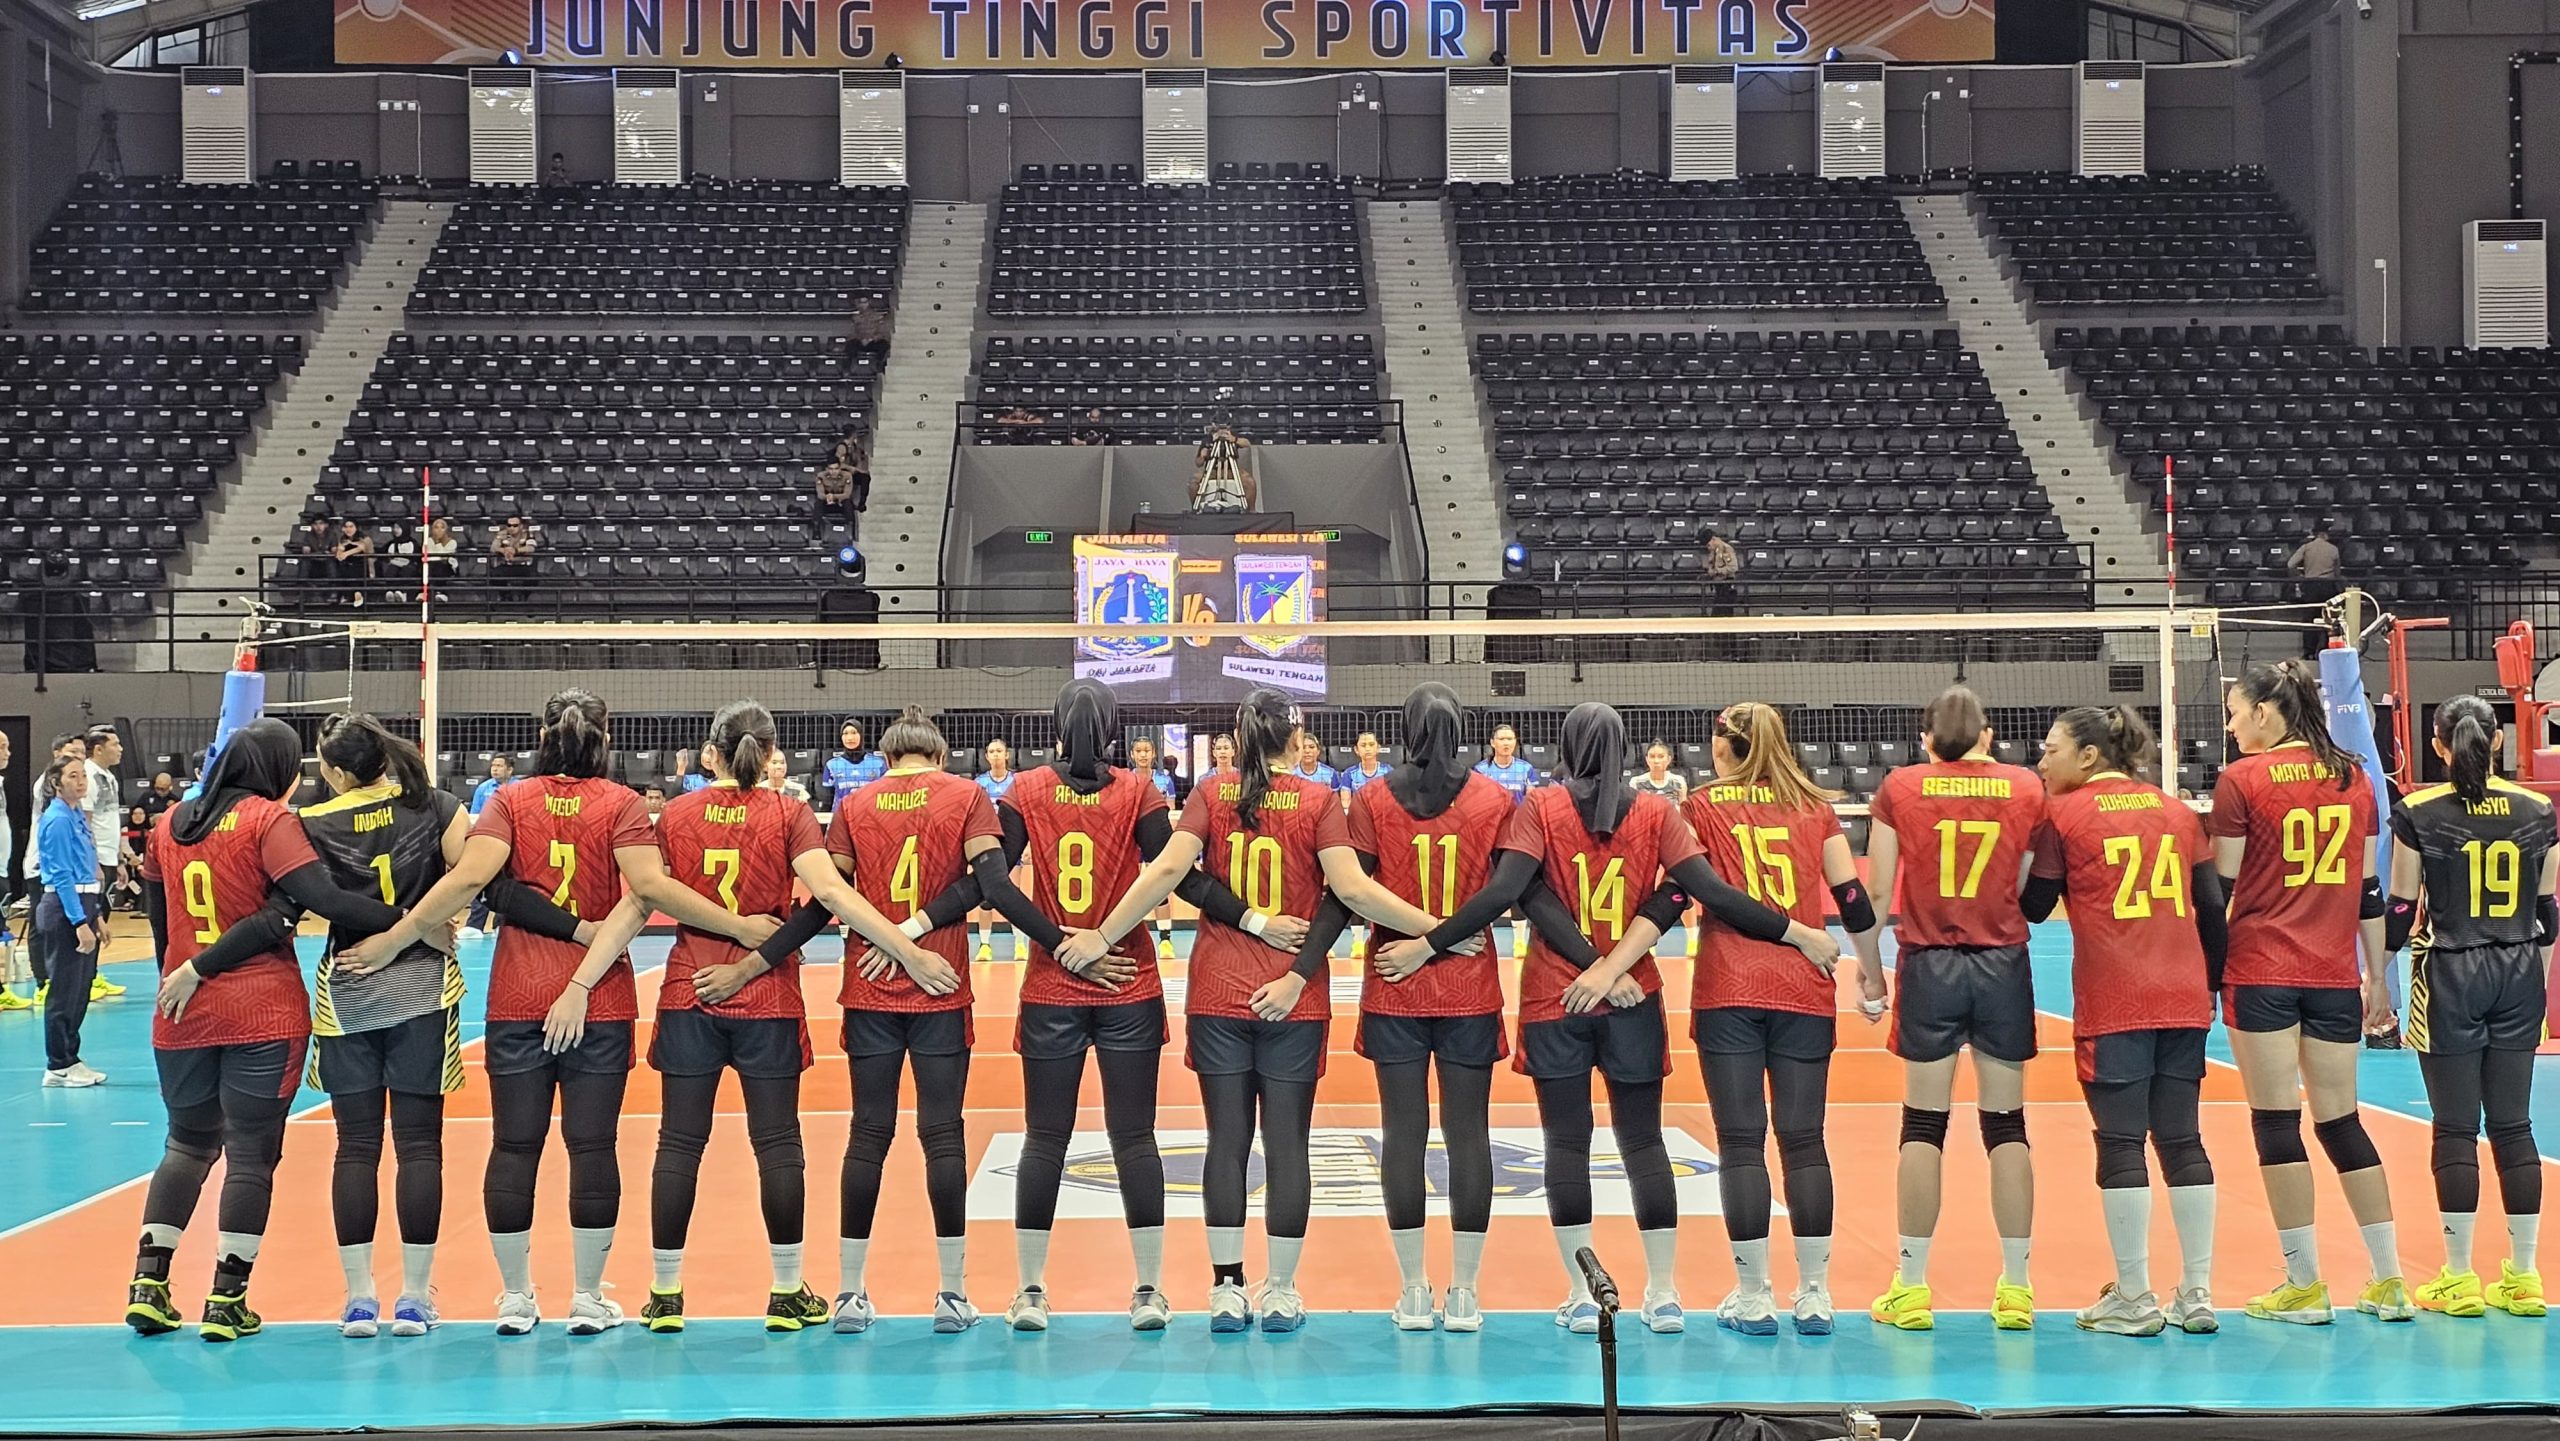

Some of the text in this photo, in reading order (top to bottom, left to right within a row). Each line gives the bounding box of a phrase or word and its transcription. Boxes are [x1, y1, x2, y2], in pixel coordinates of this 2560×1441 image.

[526, 0, 1811, 60] JUNJUNG TINGGI SPORTIVITAS
[1030, 533, 1050, 541] EXIT
[1229, 662, 1275, 676] SULAWESI
[876, 787, 929, 811] MAHUZE
[2268, 763, 2310, 783] MAYA
[2461, 796, 2511, 816] TASYA
[353, 806, 394, 833] INDAH
[704, 804, 747, 824] MEIKA
[2281, 804, 2351, 888] 92
[369, 853, 396, 906] 1
[890, 834, 920, 918] 4
[1057, 831, 1094, 914] 8
[1226, 831, 1283, 917] 10
[1411, 834, 1458, 917] 11
[1572, 852, 1625, 941] 14
[1730, 823, 1797, 910] 15
[1933, 819, 2001, 898] 17
[2103, 834, 2186, 920] 24
[2461, 840, 2520, 918] 19
[183, 860, 221, 944] 9
